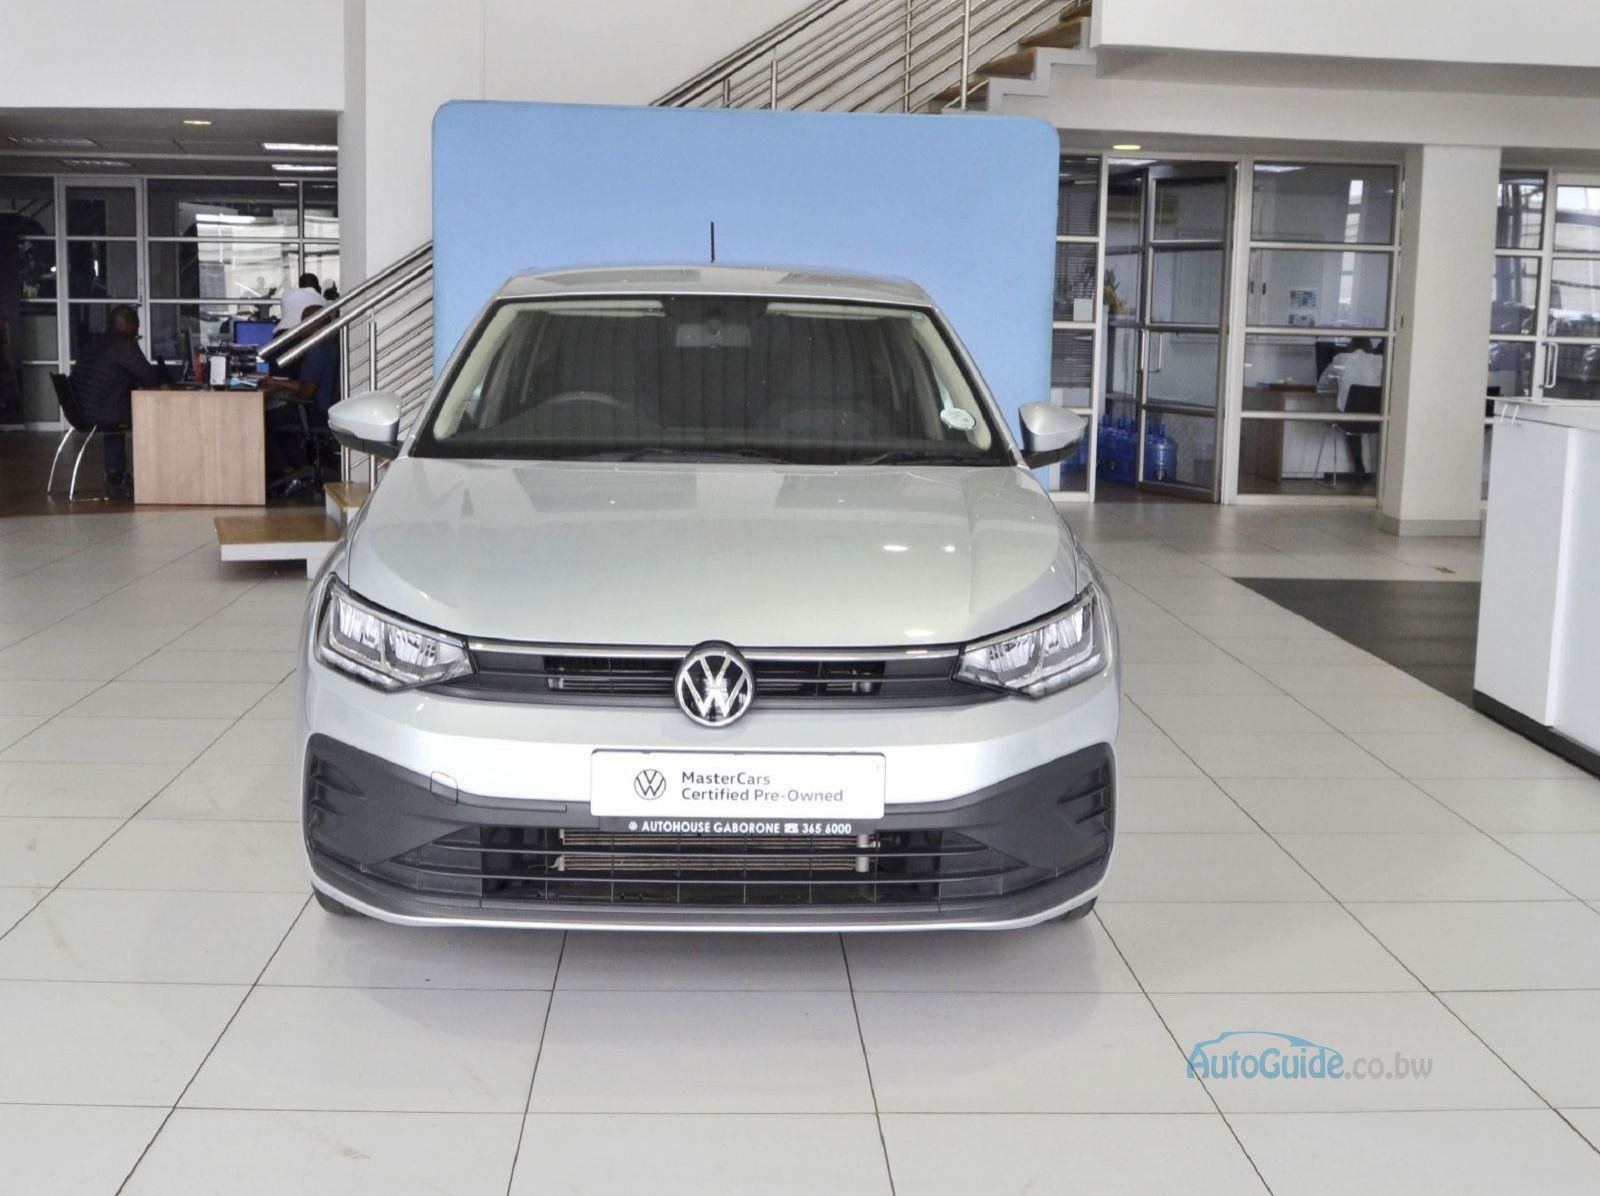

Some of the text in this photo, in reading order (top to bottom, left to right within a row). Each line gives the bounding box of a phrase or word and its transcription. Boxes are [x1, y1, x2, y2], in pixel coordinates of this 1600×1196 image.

[682, 771, 771, 786] MasterCars
[681, 788, 844, 802] Certified Pre-Owned
[641, 821, 851, 834] AUTOHOUSE GABORONE 365 6000
